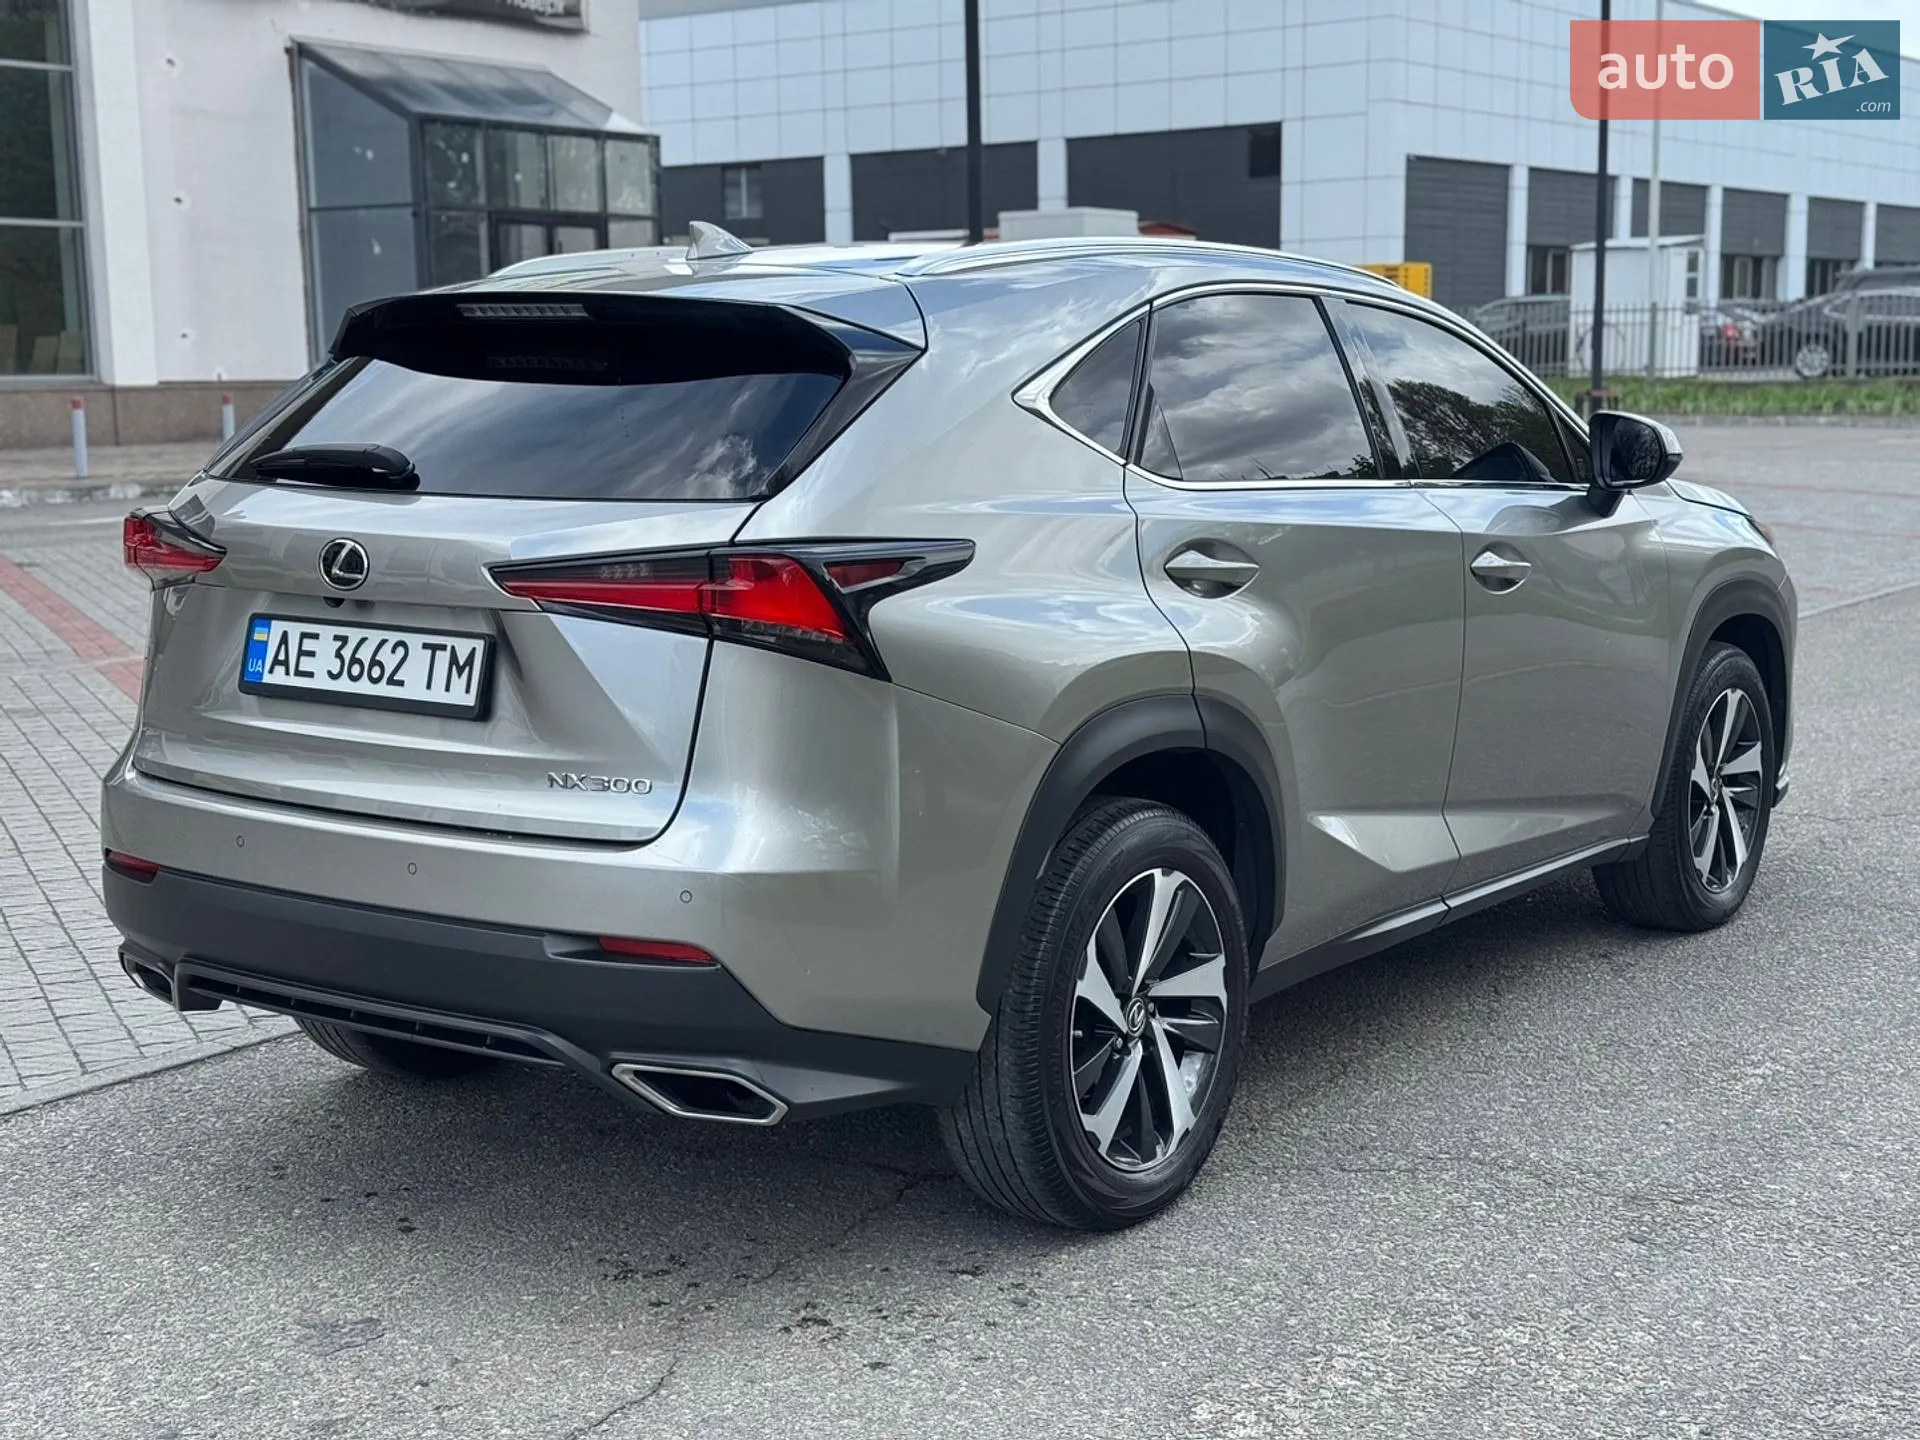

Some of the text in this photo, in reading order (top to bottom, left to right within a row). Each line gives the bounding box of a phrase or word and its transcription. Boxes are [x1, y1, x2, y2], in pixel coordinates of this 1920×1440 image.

[248, 658, 263, 673] UA
[268, 630, 477, 694] AE 3662 TM
